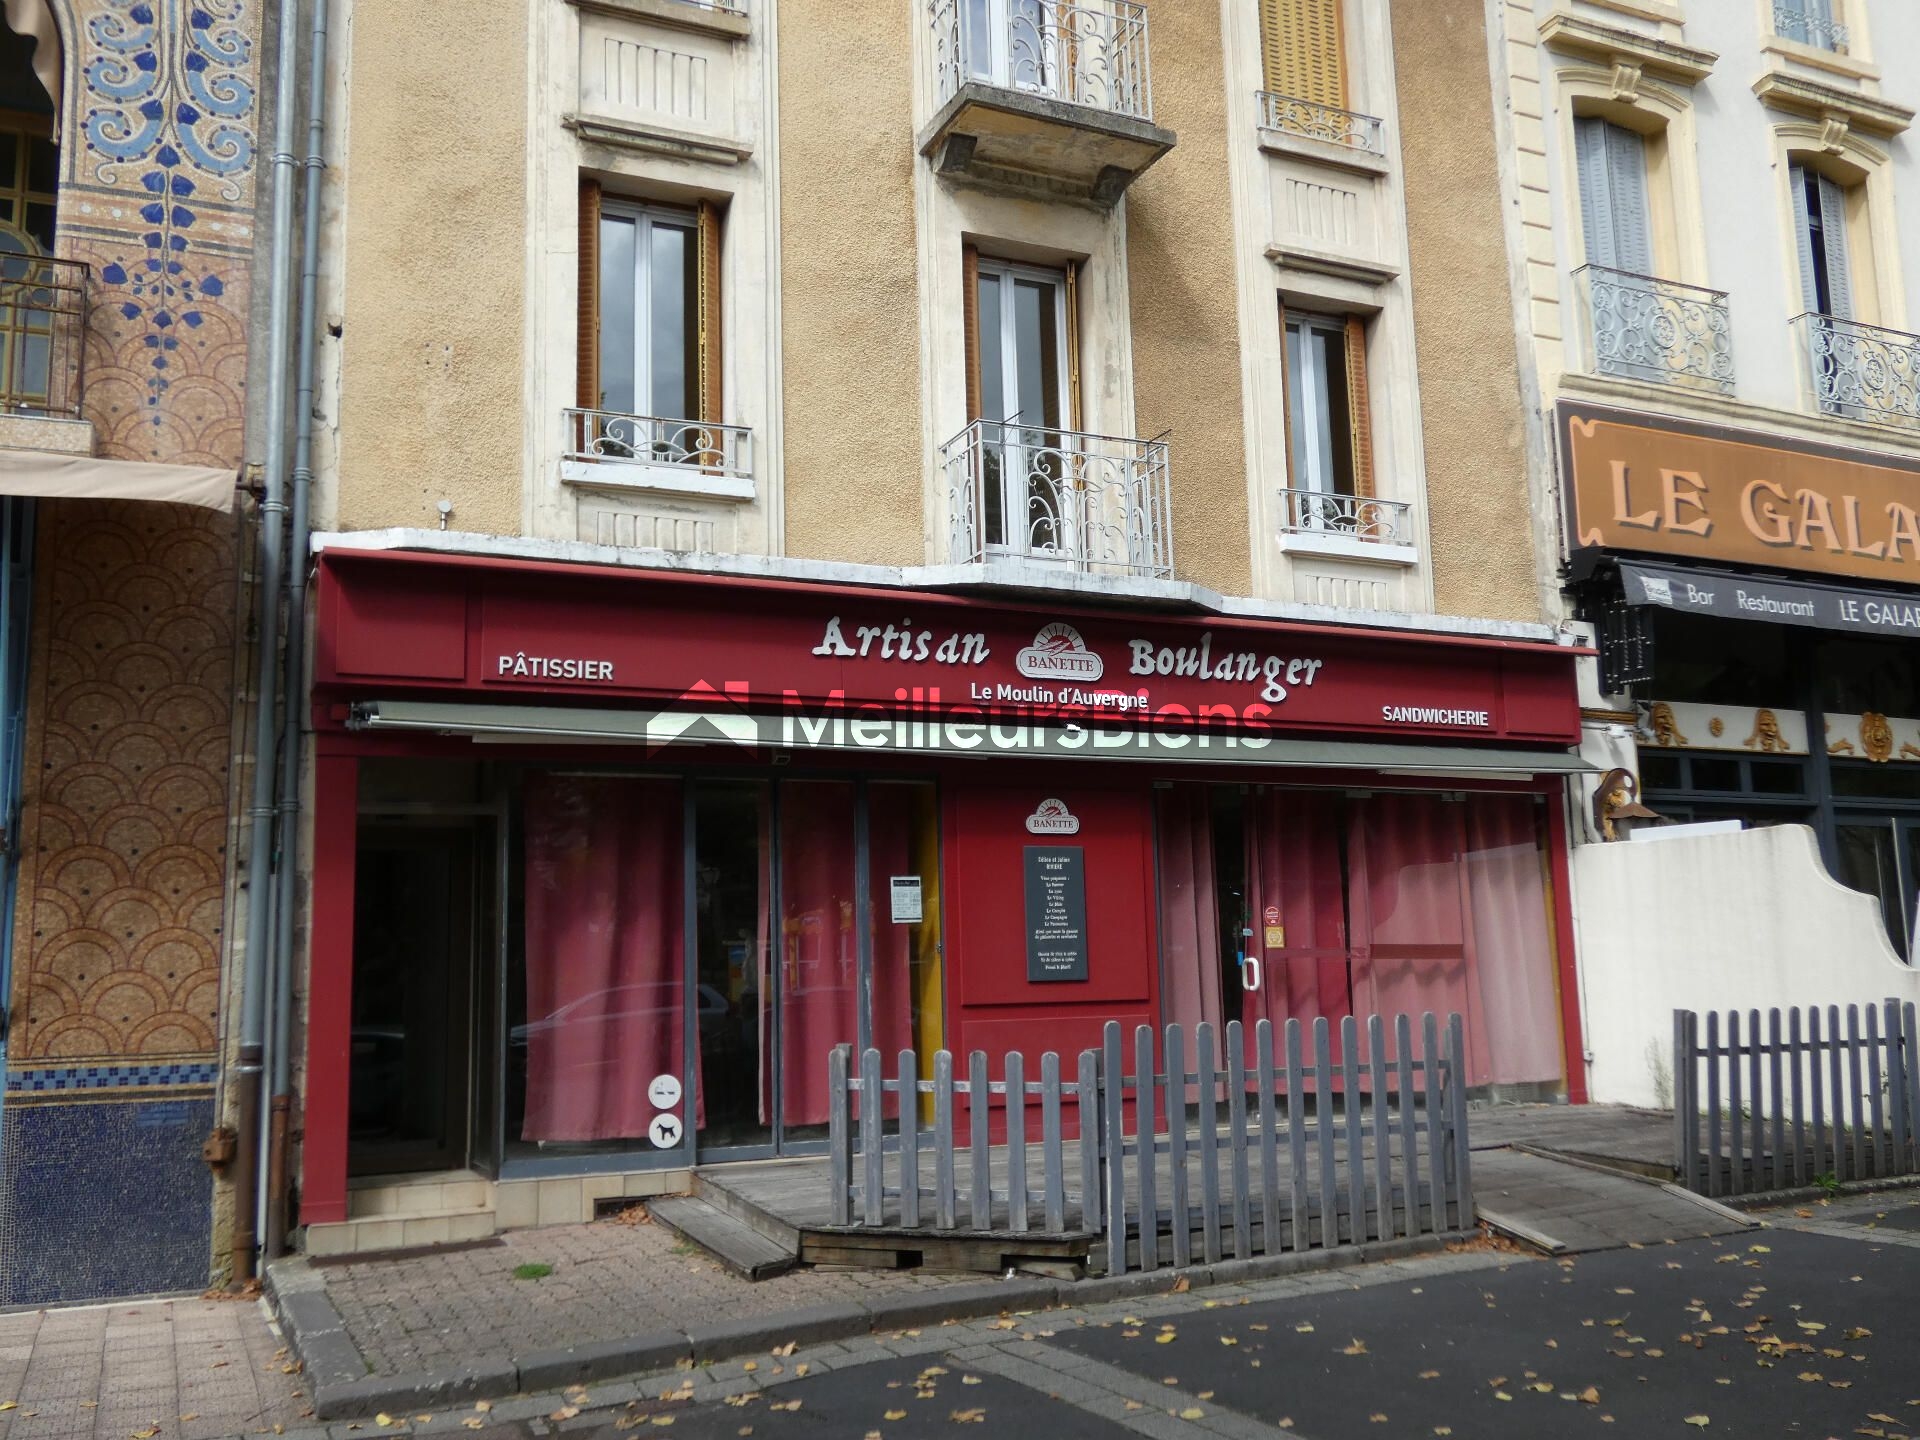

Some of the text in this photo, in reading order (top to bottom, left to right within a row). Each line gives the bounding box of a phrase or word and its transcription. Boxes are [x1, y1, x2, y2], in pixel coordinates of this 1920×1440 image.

[1609, 460, 1920, 561] LE GALA
[1687, 583, 1715, 606] Bar
[1737, 589, 1814, 617] Restaurant
[1839, 600, 1861, 622] LE
[498, 652, 614, 680] PÂTISSIER
[811, 616, 1323, 702] Artisan Boulanger
[1028, 655, 1094, 672] BANETTE
[971, 682, 1148, 711] Le Moulin d'Auvergne
[1382, 705, 1489, 726] SANDWICHERIE
[1033, 819, 1073, 828] BANETTE
